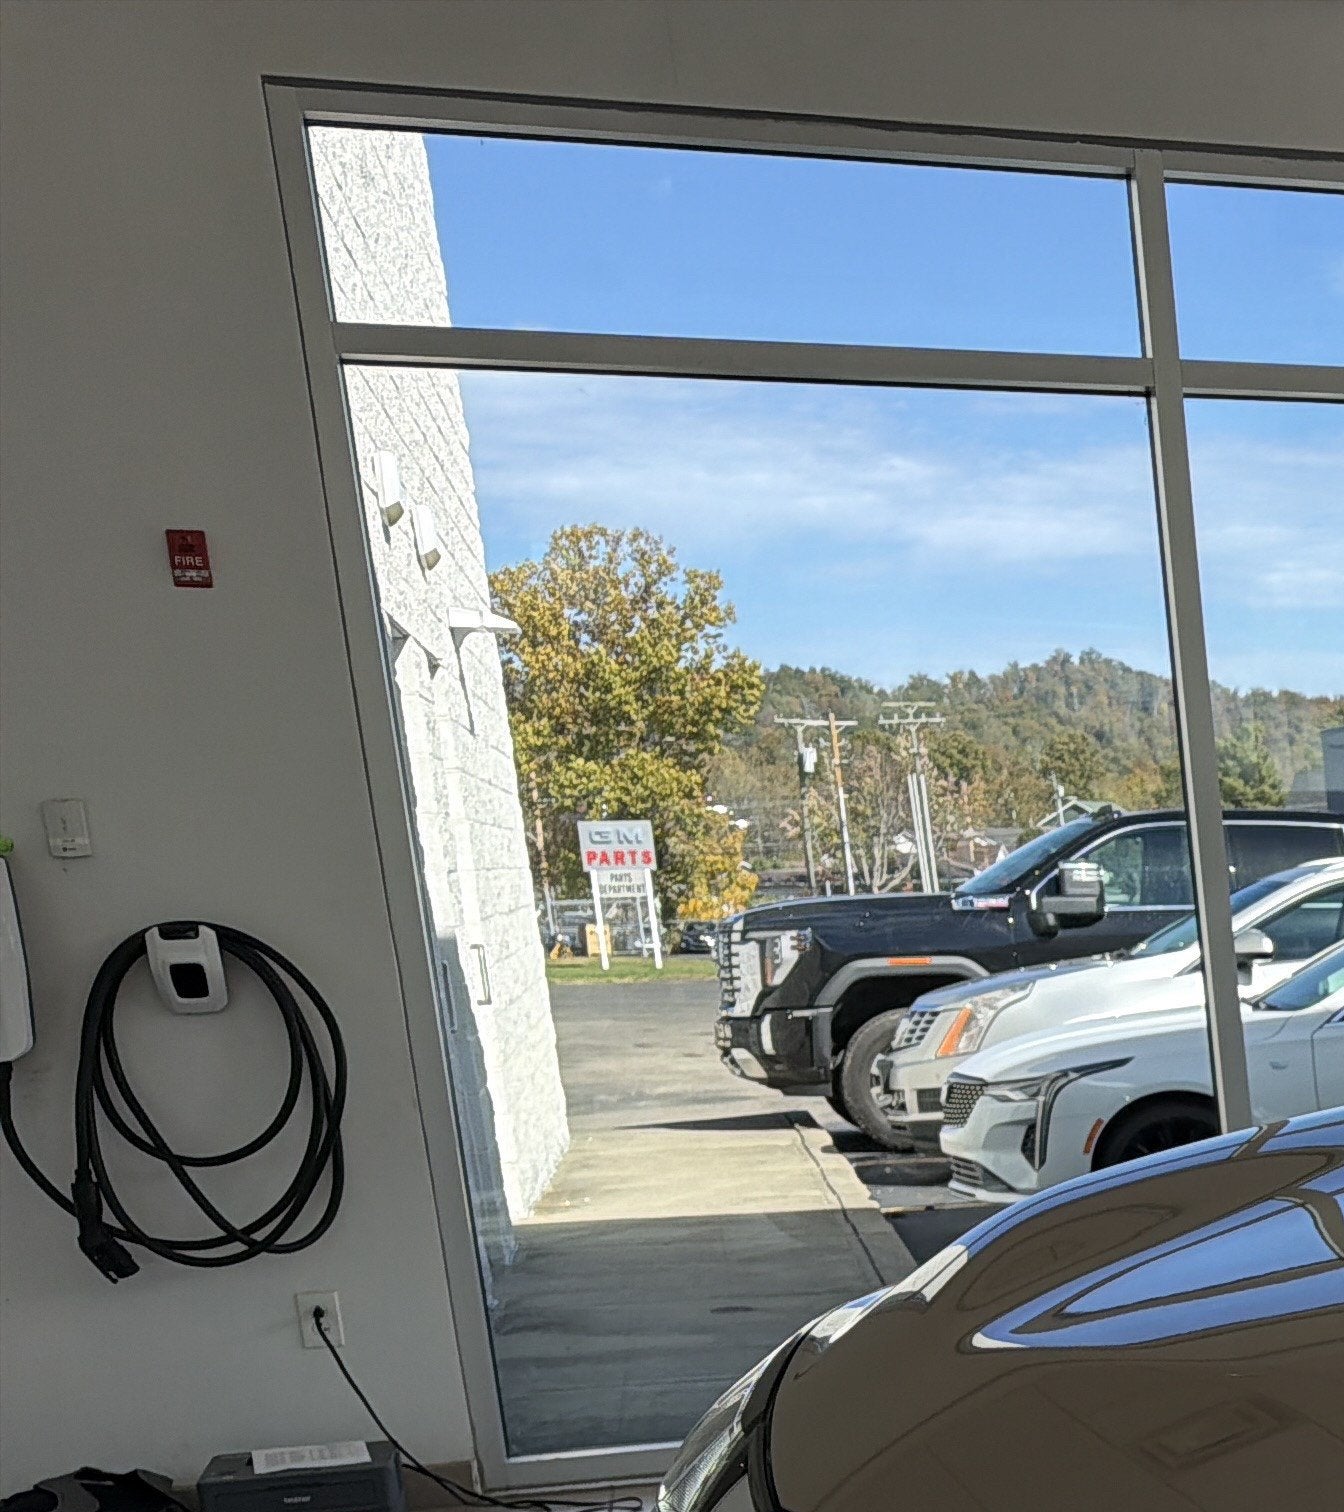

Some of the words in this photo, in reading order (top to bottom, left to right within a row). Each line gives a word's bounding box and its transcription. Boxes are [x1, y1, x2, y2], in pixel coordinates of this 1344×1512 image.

[174, 555, 204, 567] FIRE
[588, 829, 643, 845] GM
[584, 850, 653, 867] PARTS
